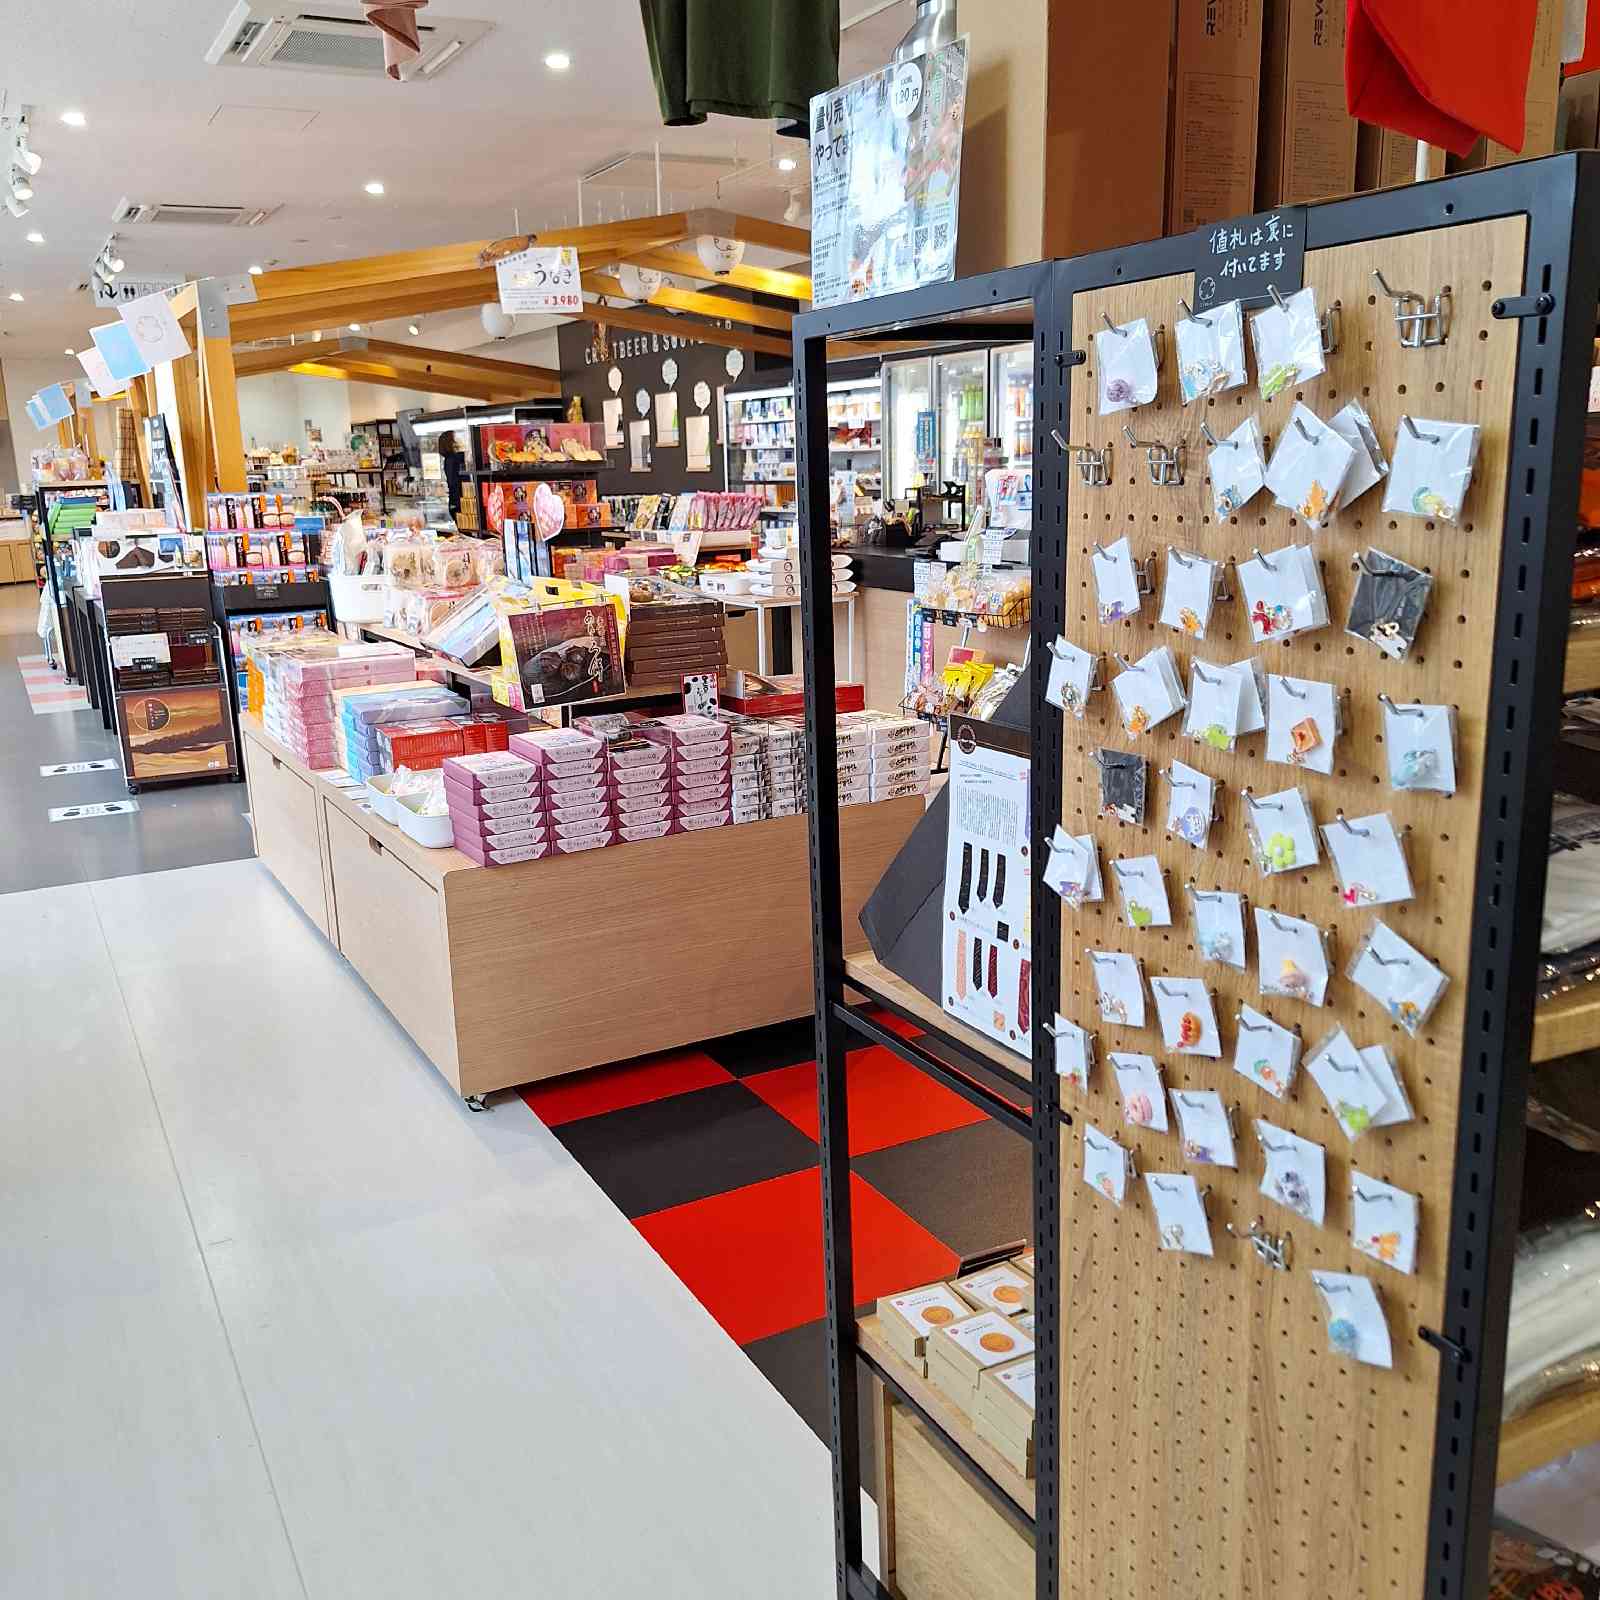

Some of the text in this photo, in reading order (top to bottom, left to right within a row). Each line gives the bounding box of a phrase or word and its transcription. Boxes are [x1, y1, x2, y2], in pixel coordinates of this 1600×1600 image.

[1209, 214, 1294, 255] 値札は裏に
[1220, 247, 1286, 279] 付いてます
[584, 336, 649, 365] CRTBEER
